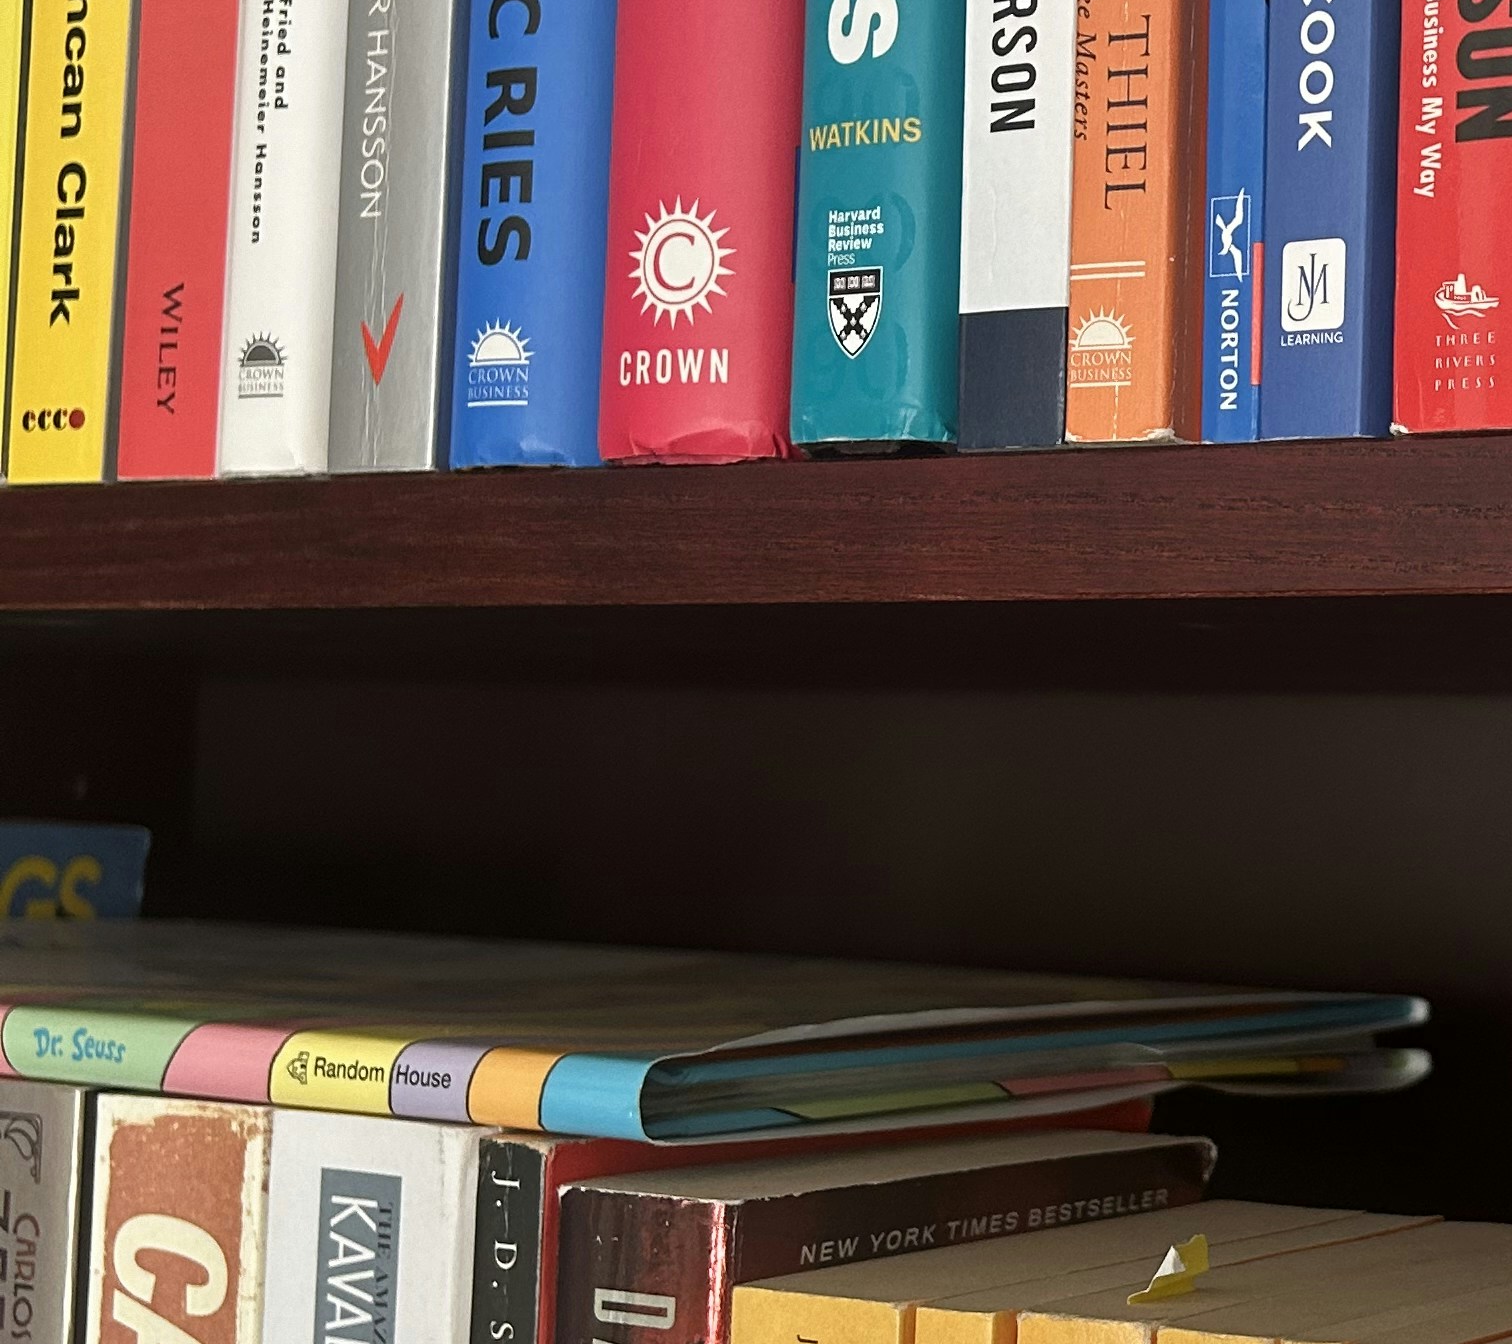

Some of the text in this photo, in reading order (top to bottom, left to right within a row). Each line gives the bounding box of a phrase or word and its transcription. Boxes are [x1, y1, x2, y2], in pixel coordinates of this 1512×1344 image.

[273, 65, 289, 112] and
[808, 116, 923, 153] WATKINS
[477, 66, 538, 267] RIES
[49, 161, 87, 327] Clark
[156, 282, 185, 416] WILEY
[619, 348, 729, 387] CROWN
[1219, 288, 1239, 412] NORTON
[33, 1027, 127, 1064] Dr. Seuss
[313, 1055, 452, 1089] Random House
[491, 1170, 521, 1208] J.
[799, 1187, 1169, 1266] NEW YORK TIMES BESTSELLER
[10, 1212, 41, 1343] CARLOS
[491, 1240, 518, 1290] D.
